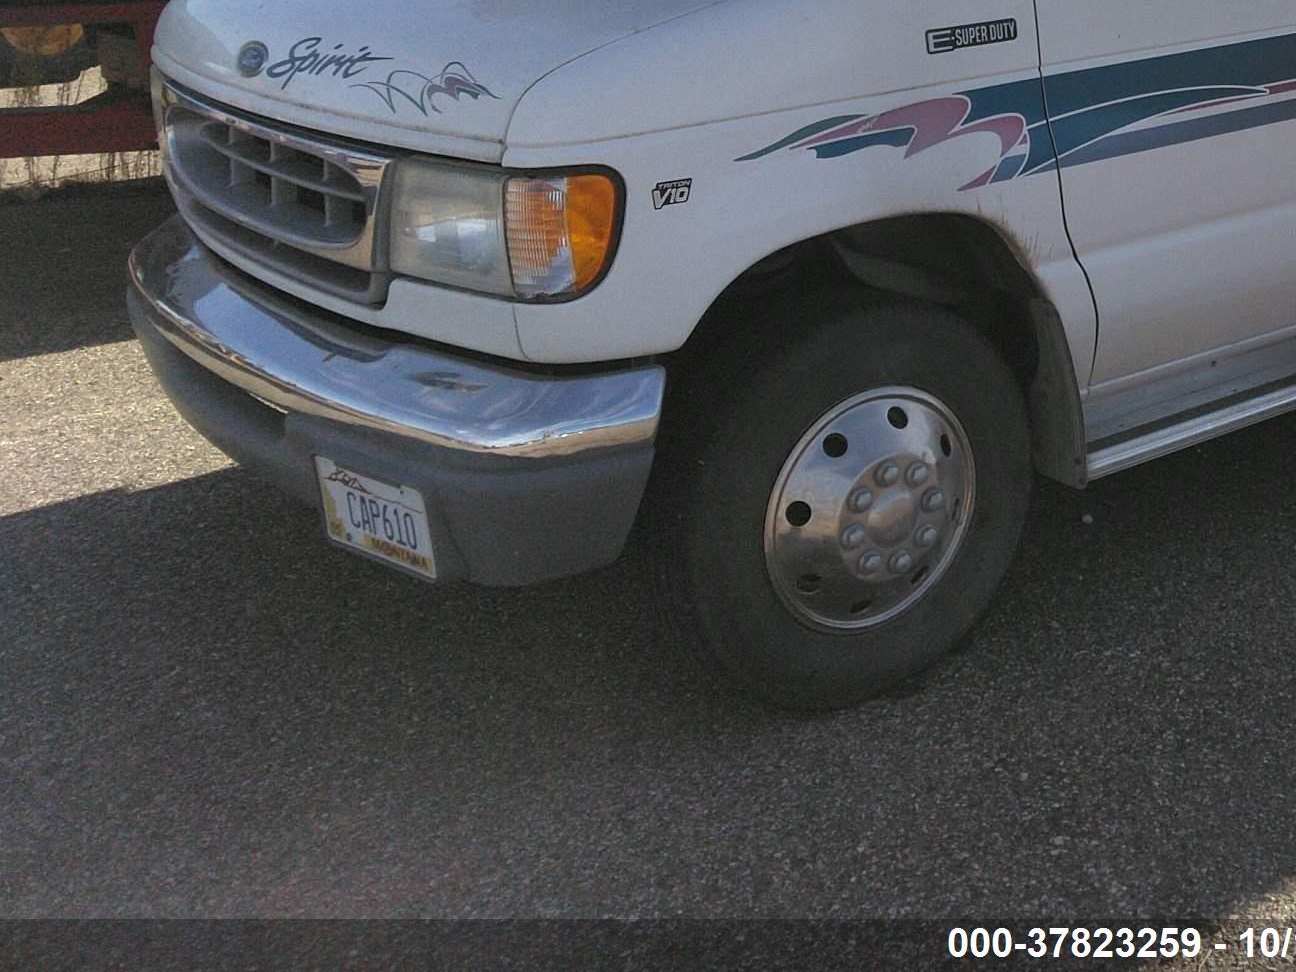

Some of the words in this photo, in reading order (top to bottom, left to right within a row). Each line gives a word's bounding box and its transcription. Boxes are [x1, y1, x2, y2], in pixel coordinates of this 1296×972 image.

[954, 25, 988, 46] SUPER
[989, 20, 1015, 42] DUTY
[266, 36, 395, 91] Spirit
[653, 187, 689, 209] V10
[346, 491, 417, 550] CAP610
